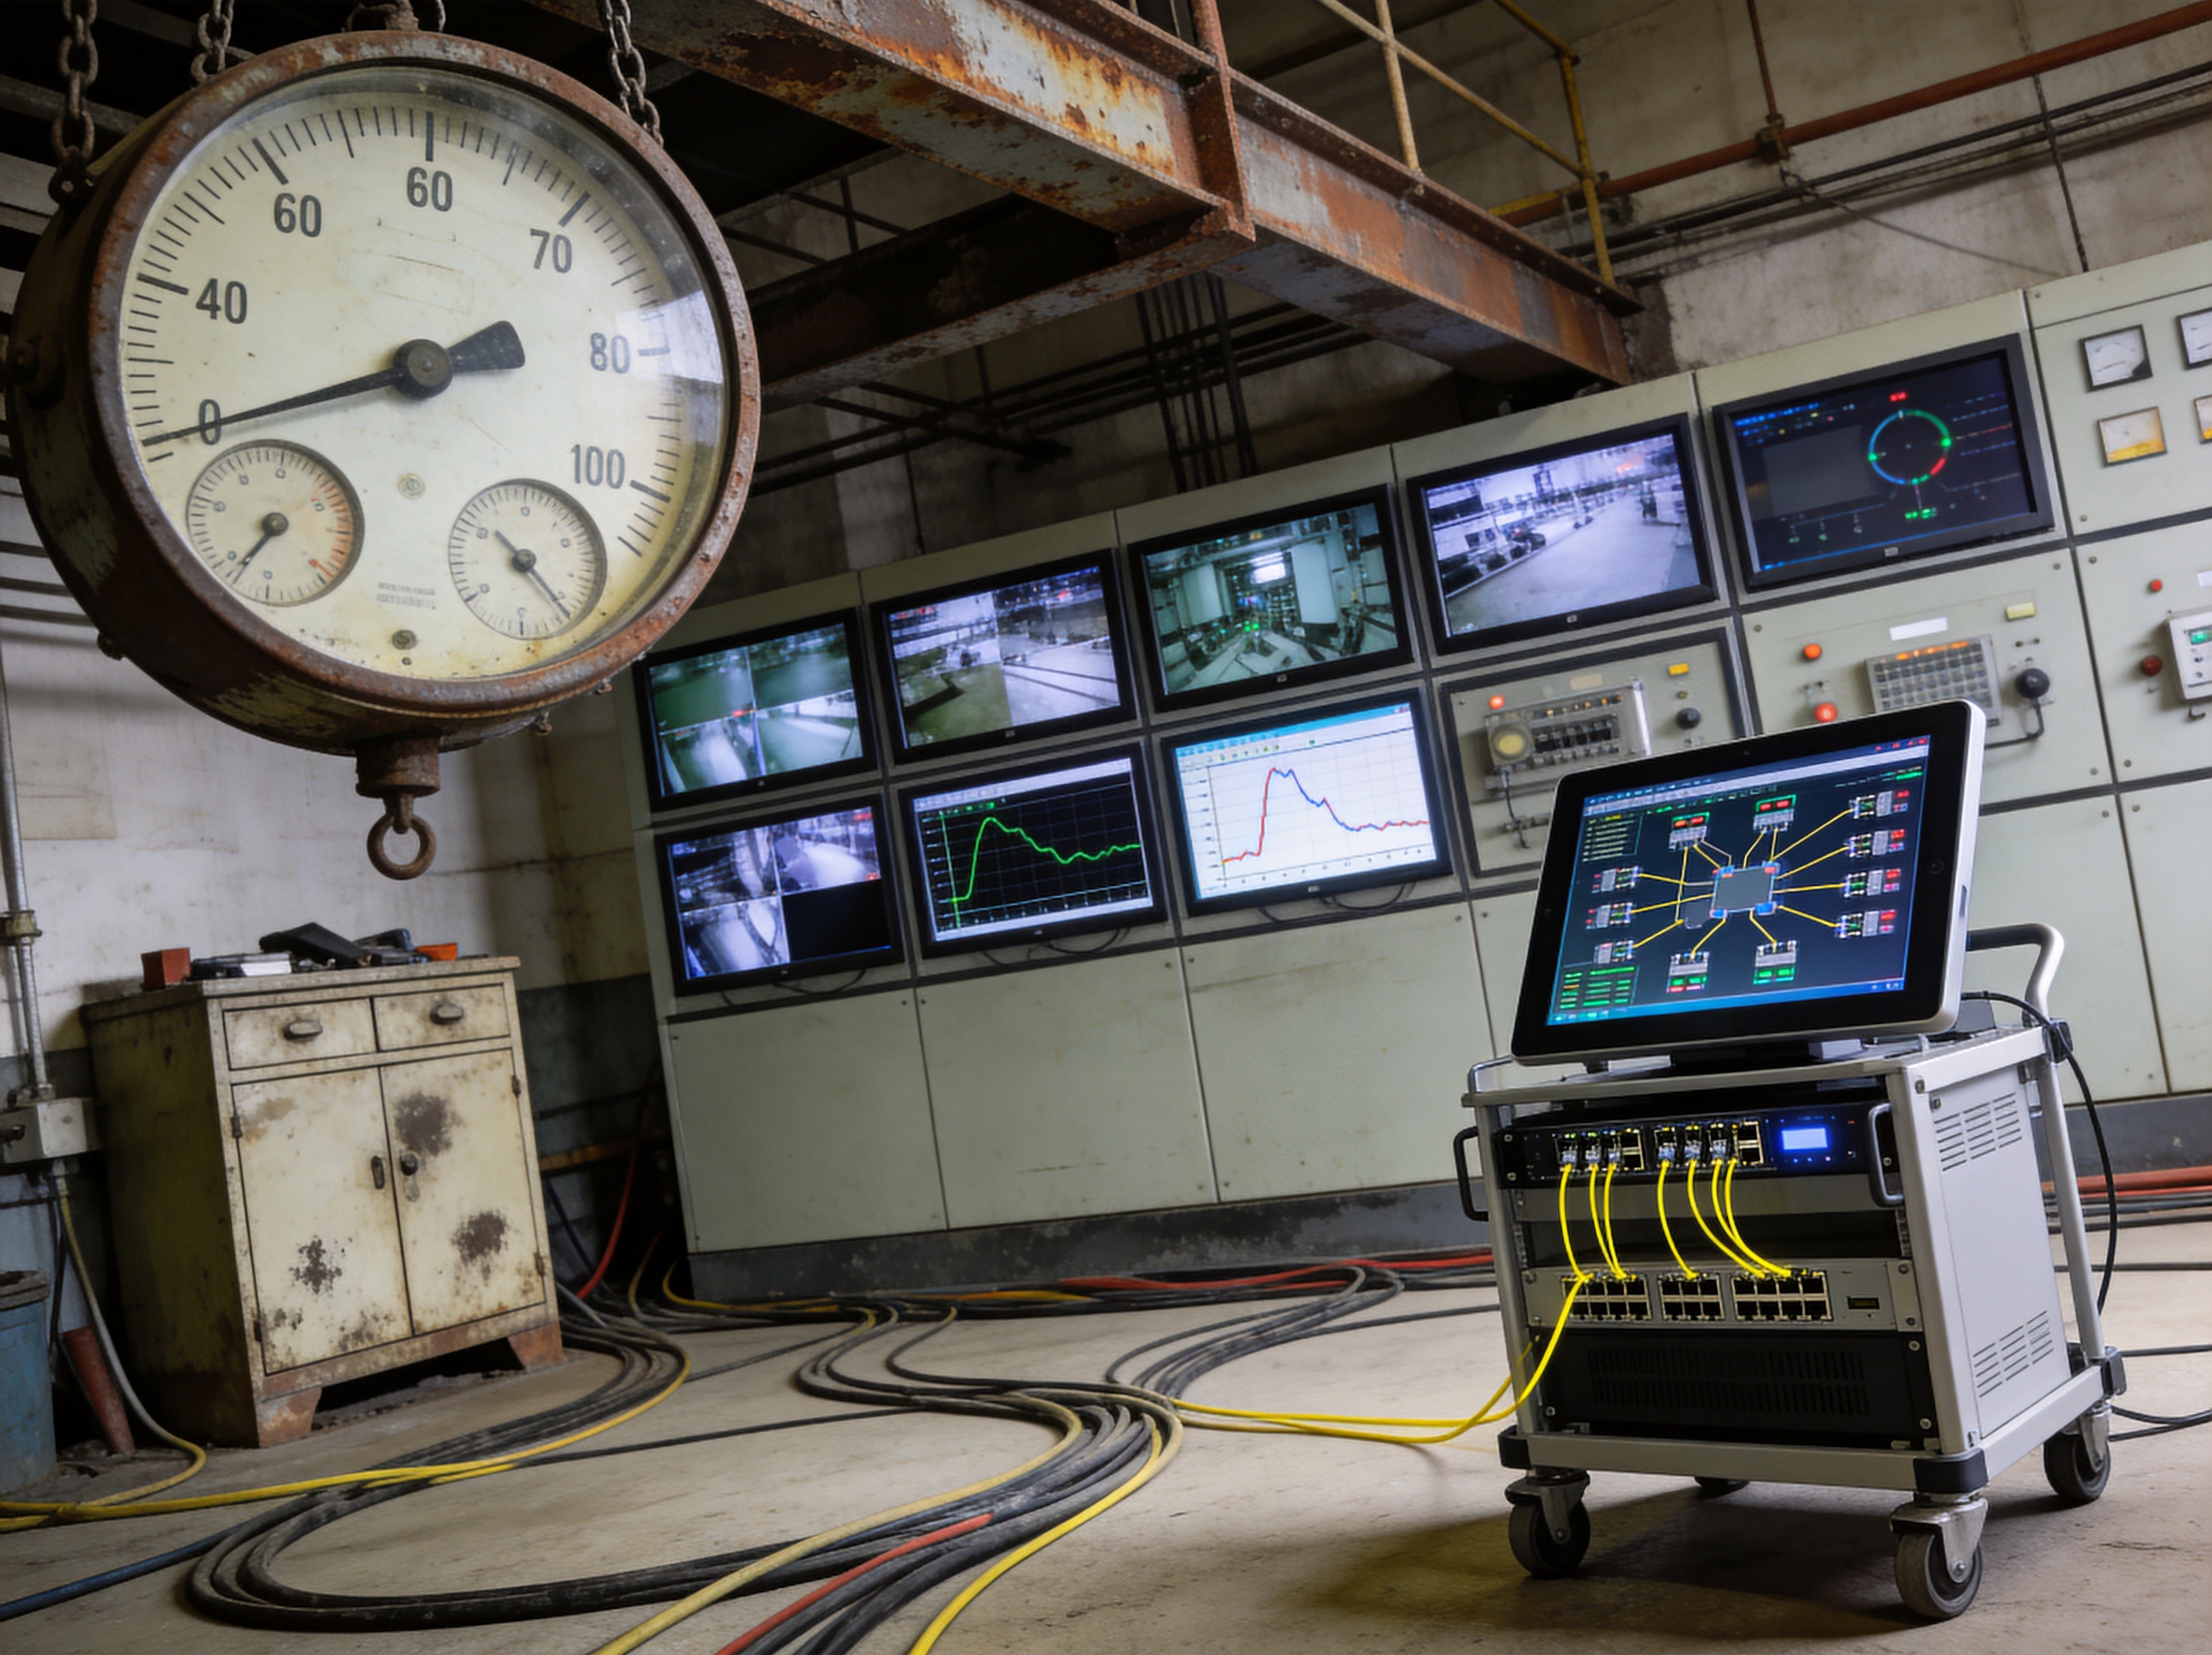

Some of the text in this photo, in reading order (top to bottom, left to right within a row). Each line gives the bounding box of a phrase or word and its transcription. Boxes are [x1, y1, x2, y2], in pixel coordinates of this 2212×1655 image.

[406, 166, 453, 212] 60
[273, 192, 322, 237] 60
[529, 228, 572, 274] 70
[195, 278, 247, 324] 40
[589, 332, 630, 374] 80
[199, 399, 221, 446] 0
[570, 443, 625, 489] 100
